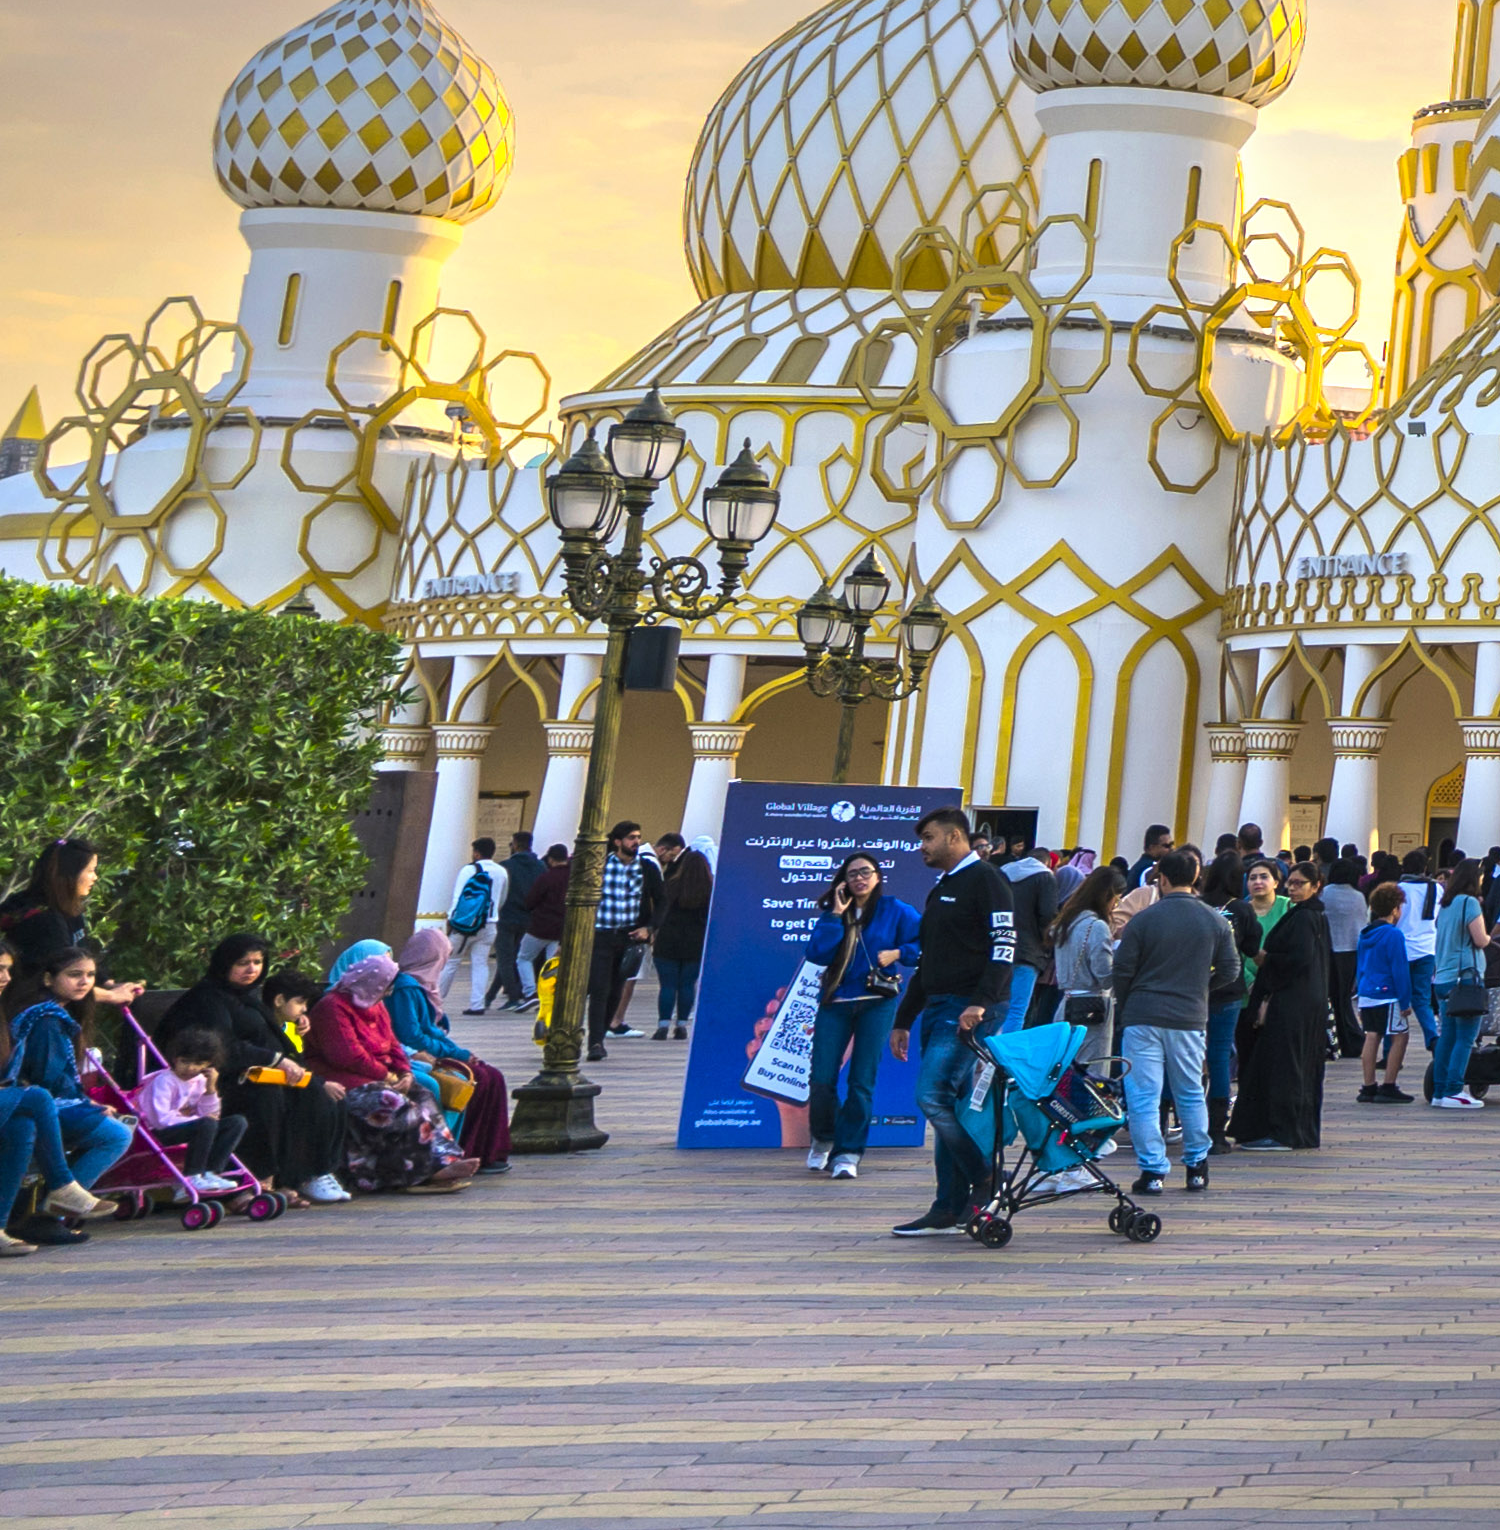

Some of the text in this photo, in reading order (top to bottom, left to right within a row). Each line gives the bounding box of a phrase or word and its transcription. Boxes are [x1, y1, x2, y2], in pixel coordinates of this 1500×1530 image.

[1297, 553, 1408, 578] ENTRANCE
[424, 572, 517, 599] ENTRANCE
[766, 802, 828, 812] Global Village
[745, 836, 793, 848] الإنترنت
[794, 839, 815, 849] عبر
[817, 837, 855, 849] اشتروا
[781, 872, 823, 883] الدخول
[762, 898, 794, 909] Save
[771, 919, 784, 928] to
[786, 920, 805, 930] get
[782, 933, 798, 941] on
[996, 947, 1012, 960] 72
[771, 1057, 805, 1075] Scan to
[757, 1067, 808, 1090] Buy Online
